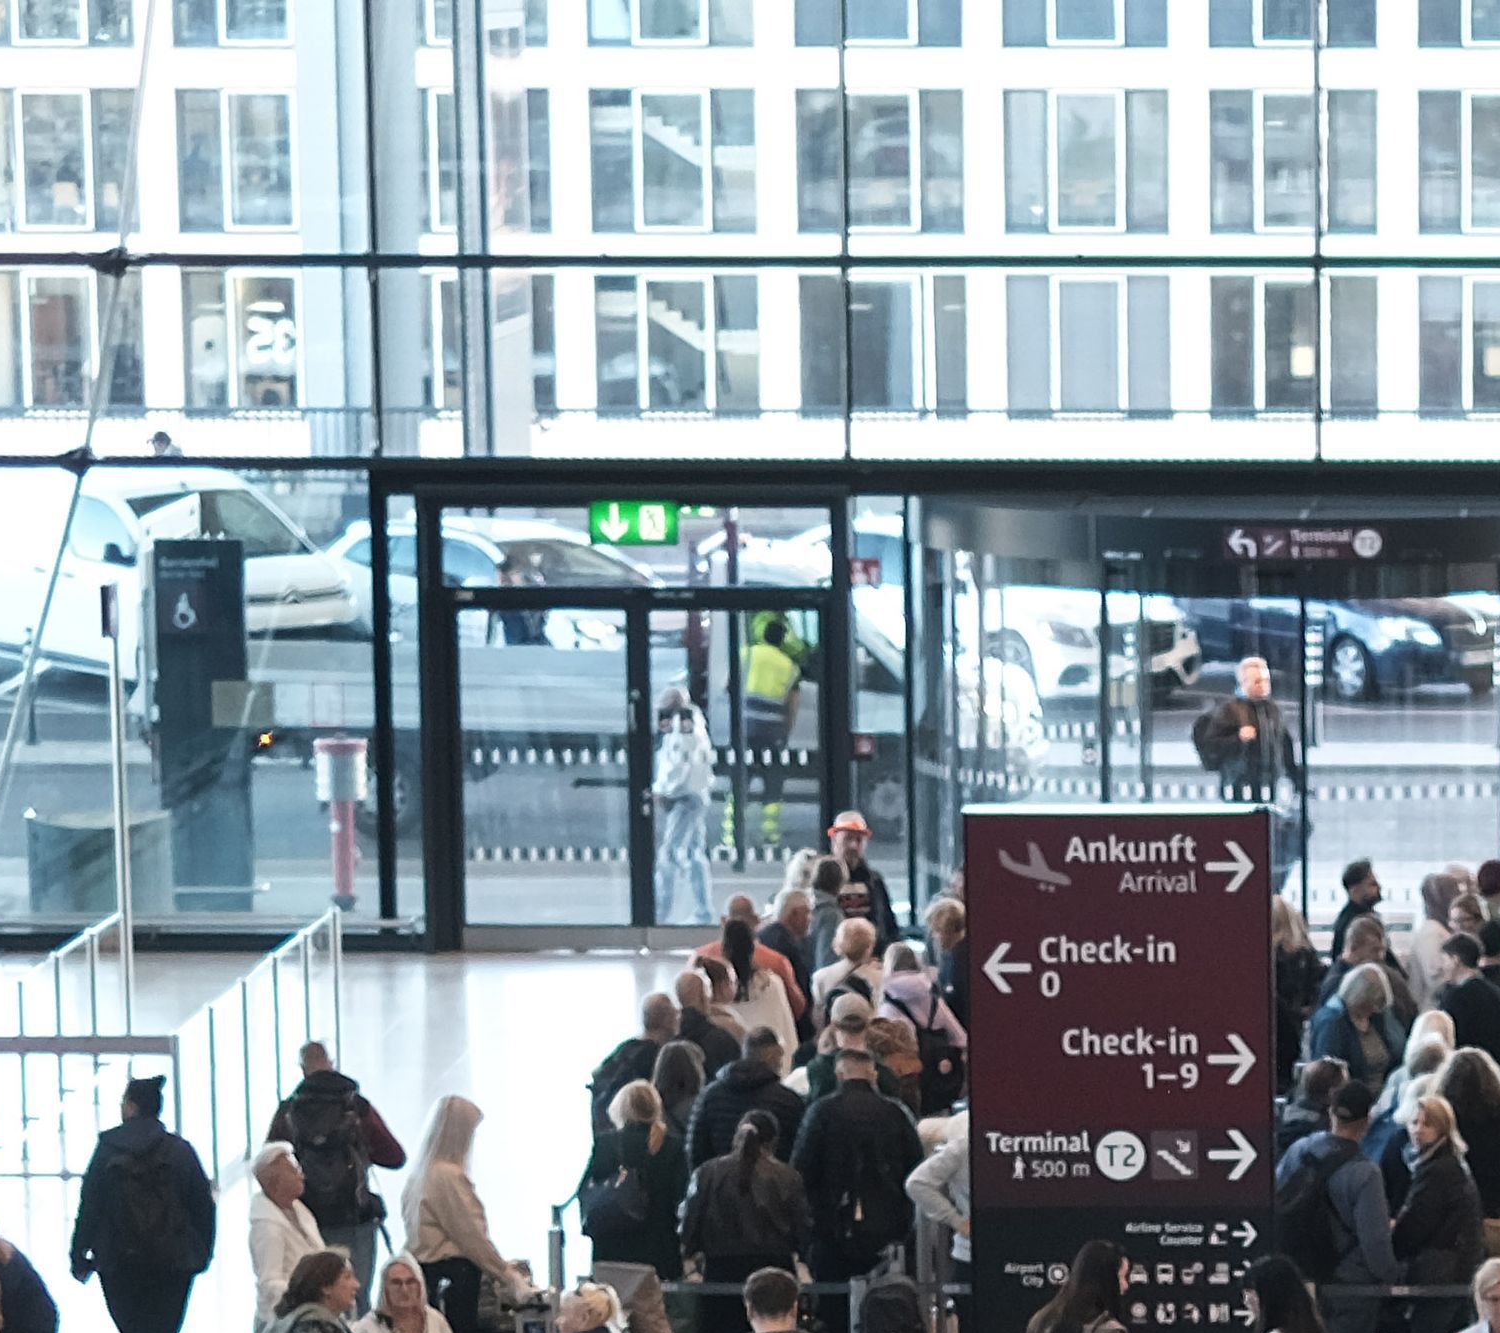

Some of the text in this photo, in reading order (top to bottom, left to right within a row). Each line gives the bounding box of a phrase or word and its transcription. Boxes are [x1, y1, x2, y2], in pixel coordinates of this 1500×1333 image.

[1065, 833, 1197, 863] Ankunft
[1119, 870, 1197, 893] Arrival
[1040, 934, 1176, 963] Check-in
[1040, 970, 1060, 998] 0
[1062, 1027, 1199, 1056] Check-in
[986, 1130, 1090, 1153] Terminal
[1104, 1143, 1137, 1168] T2
[1031, 1160, 1090, 1178] 500 m
